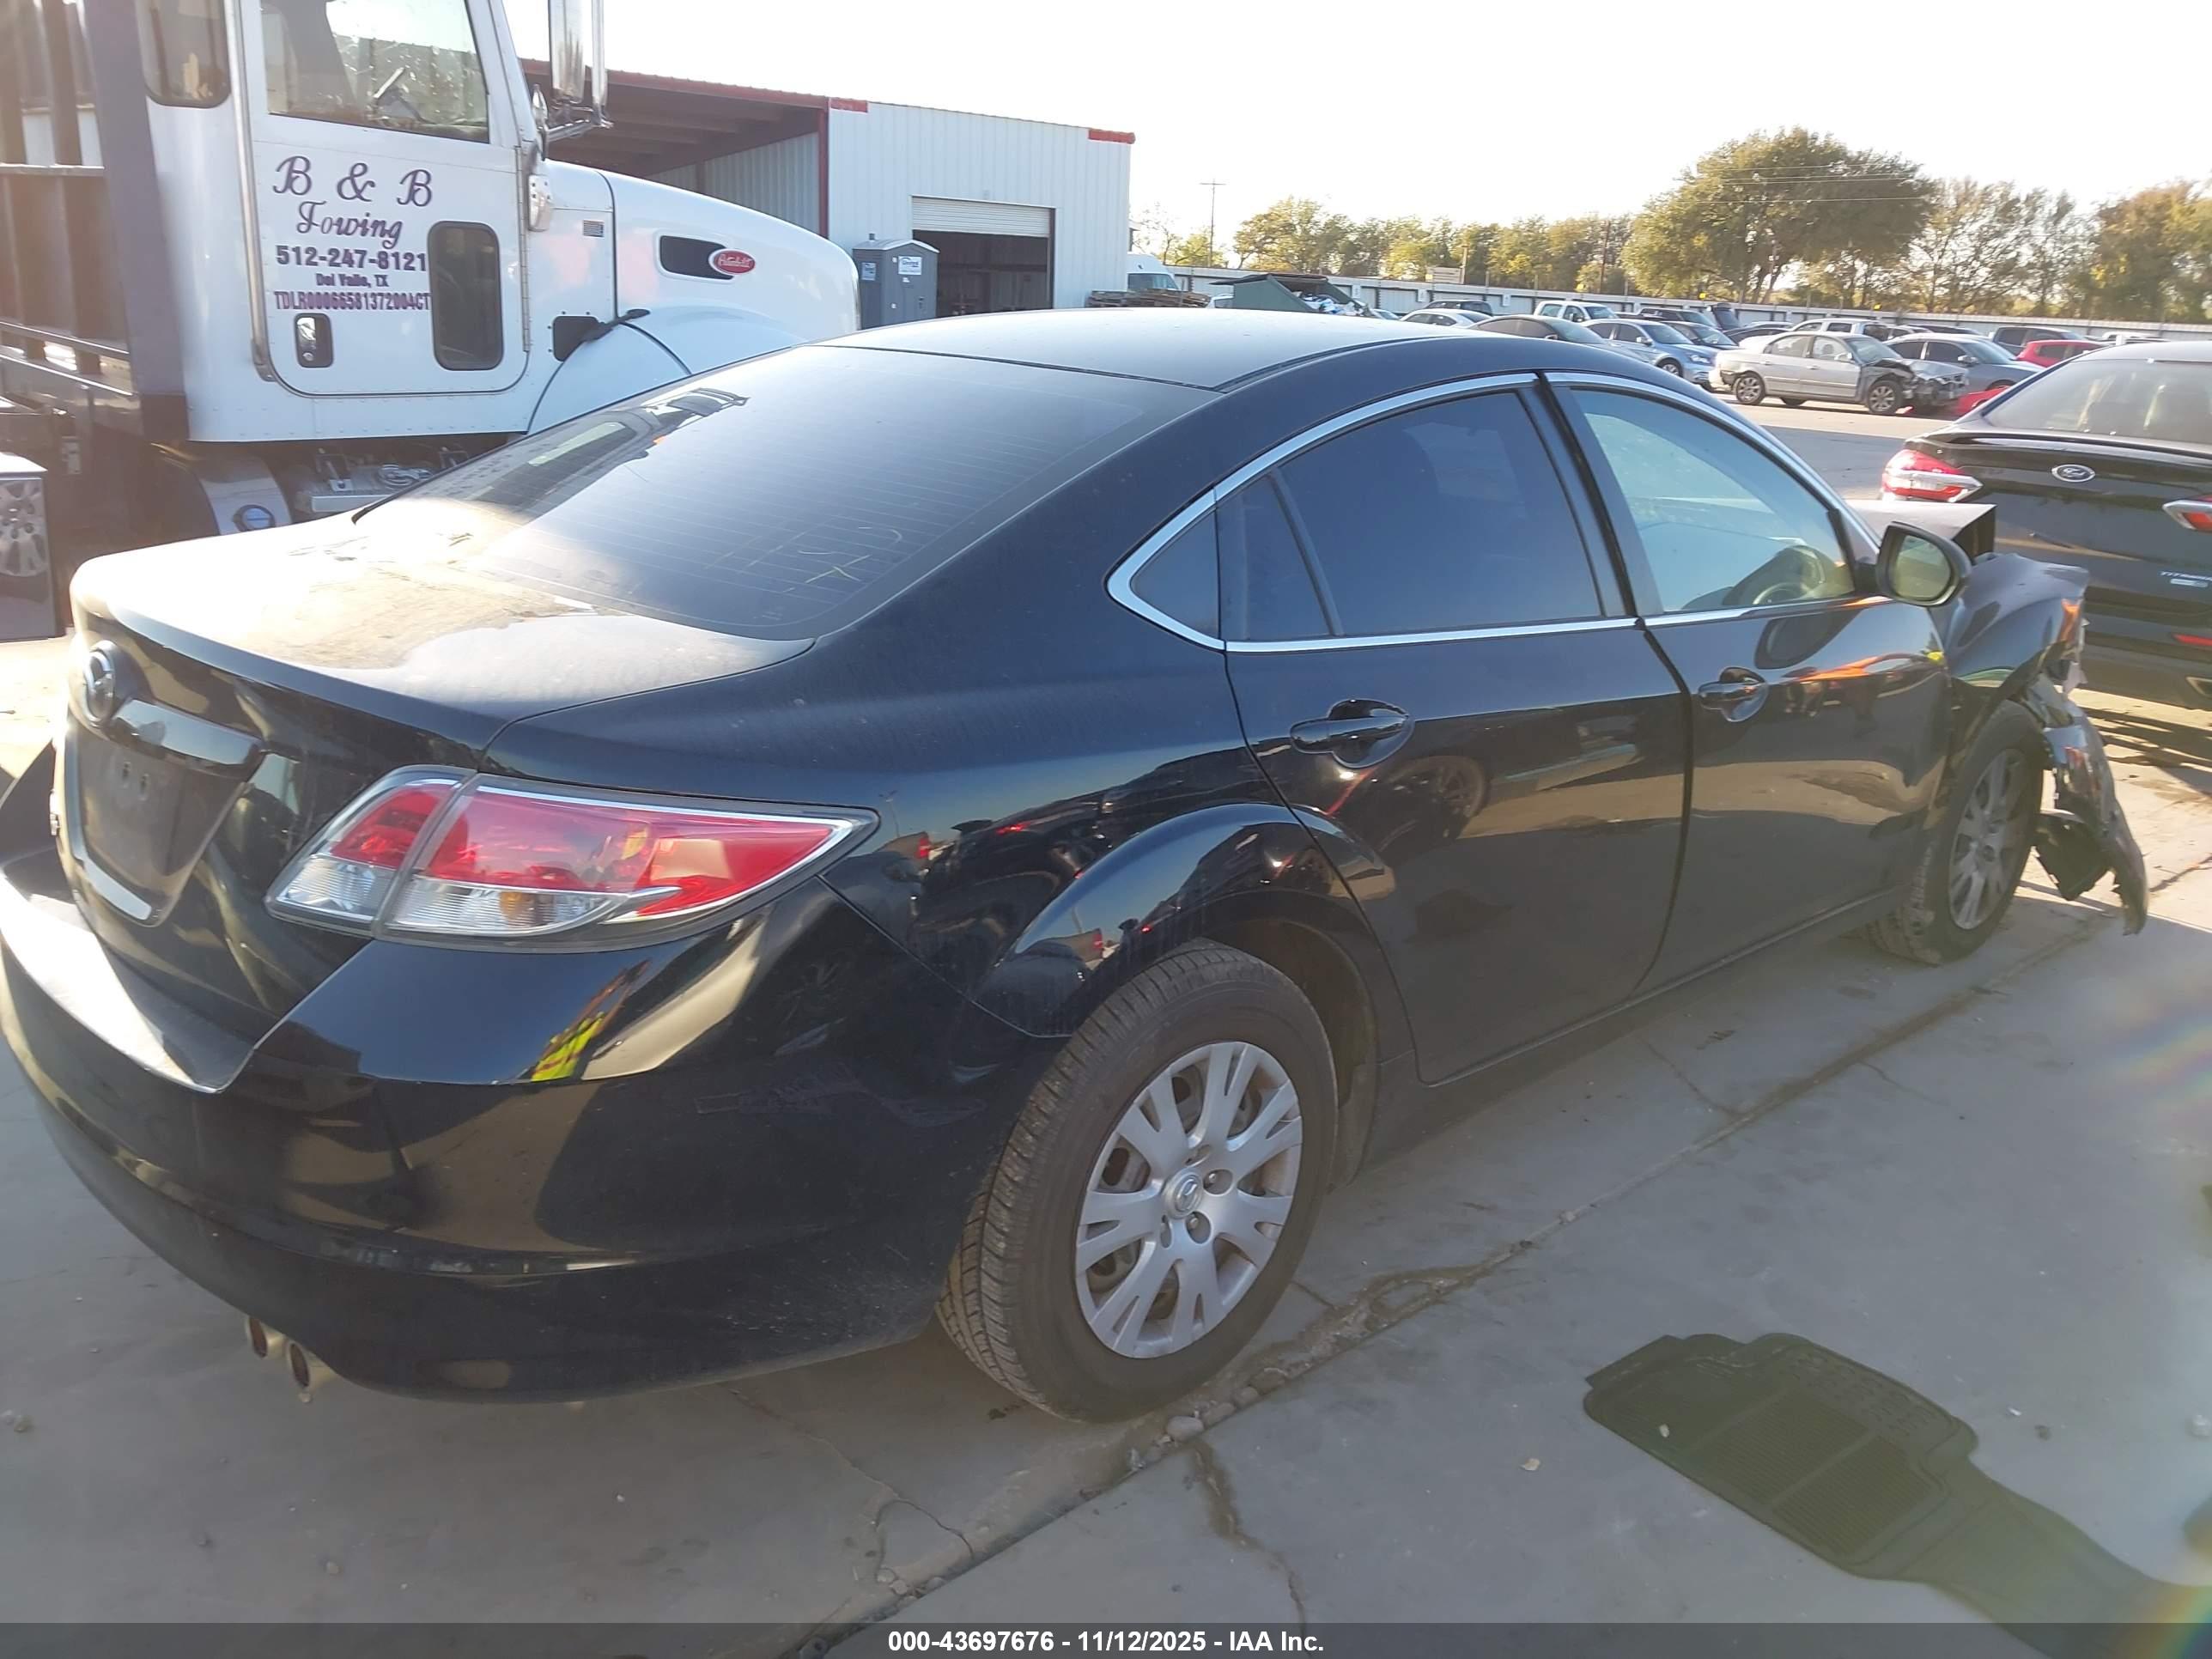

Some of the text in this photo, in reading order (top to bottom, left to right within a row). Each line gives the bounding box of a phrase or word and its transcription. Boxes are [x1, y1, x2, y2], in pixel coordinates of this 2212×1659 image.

[273, 155, 433, 207] B & B
[296, 201, 403, 249] Towing
[275, 245, 427, 272] 512-247-8121
[374, 274, 389, 287] TX
